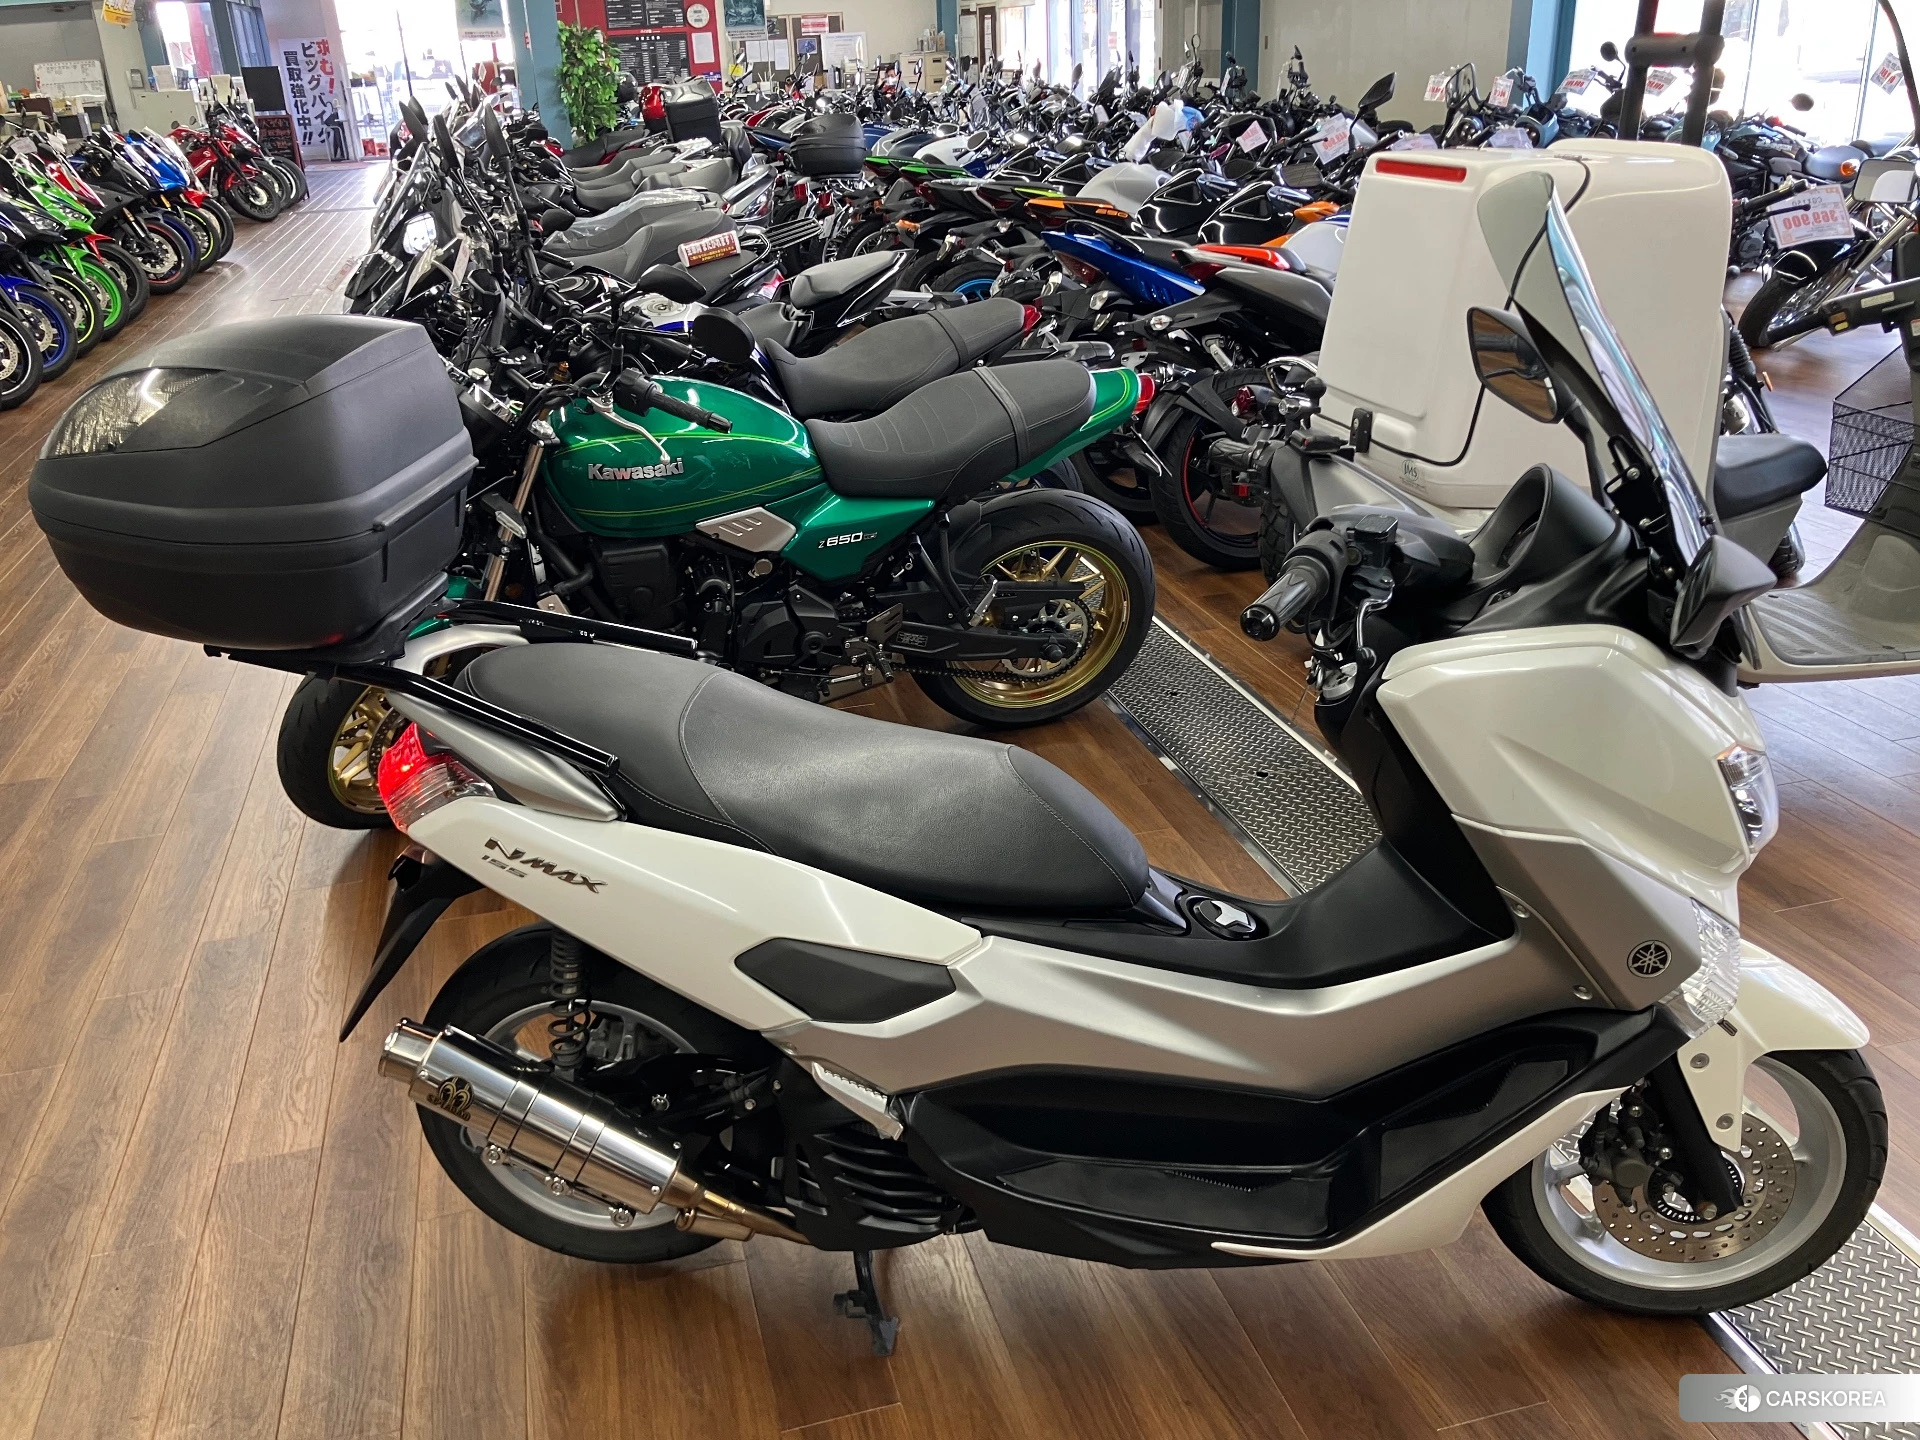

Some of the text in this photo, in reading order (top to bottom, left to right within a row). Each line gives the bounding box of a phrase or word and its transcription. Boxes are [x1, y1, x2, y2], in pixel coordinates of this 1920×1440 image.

[316, 39, 335, 94] 求む!
[587, 457, 684, 480] Kawasaki
[481, 854, 528, 878] 155
